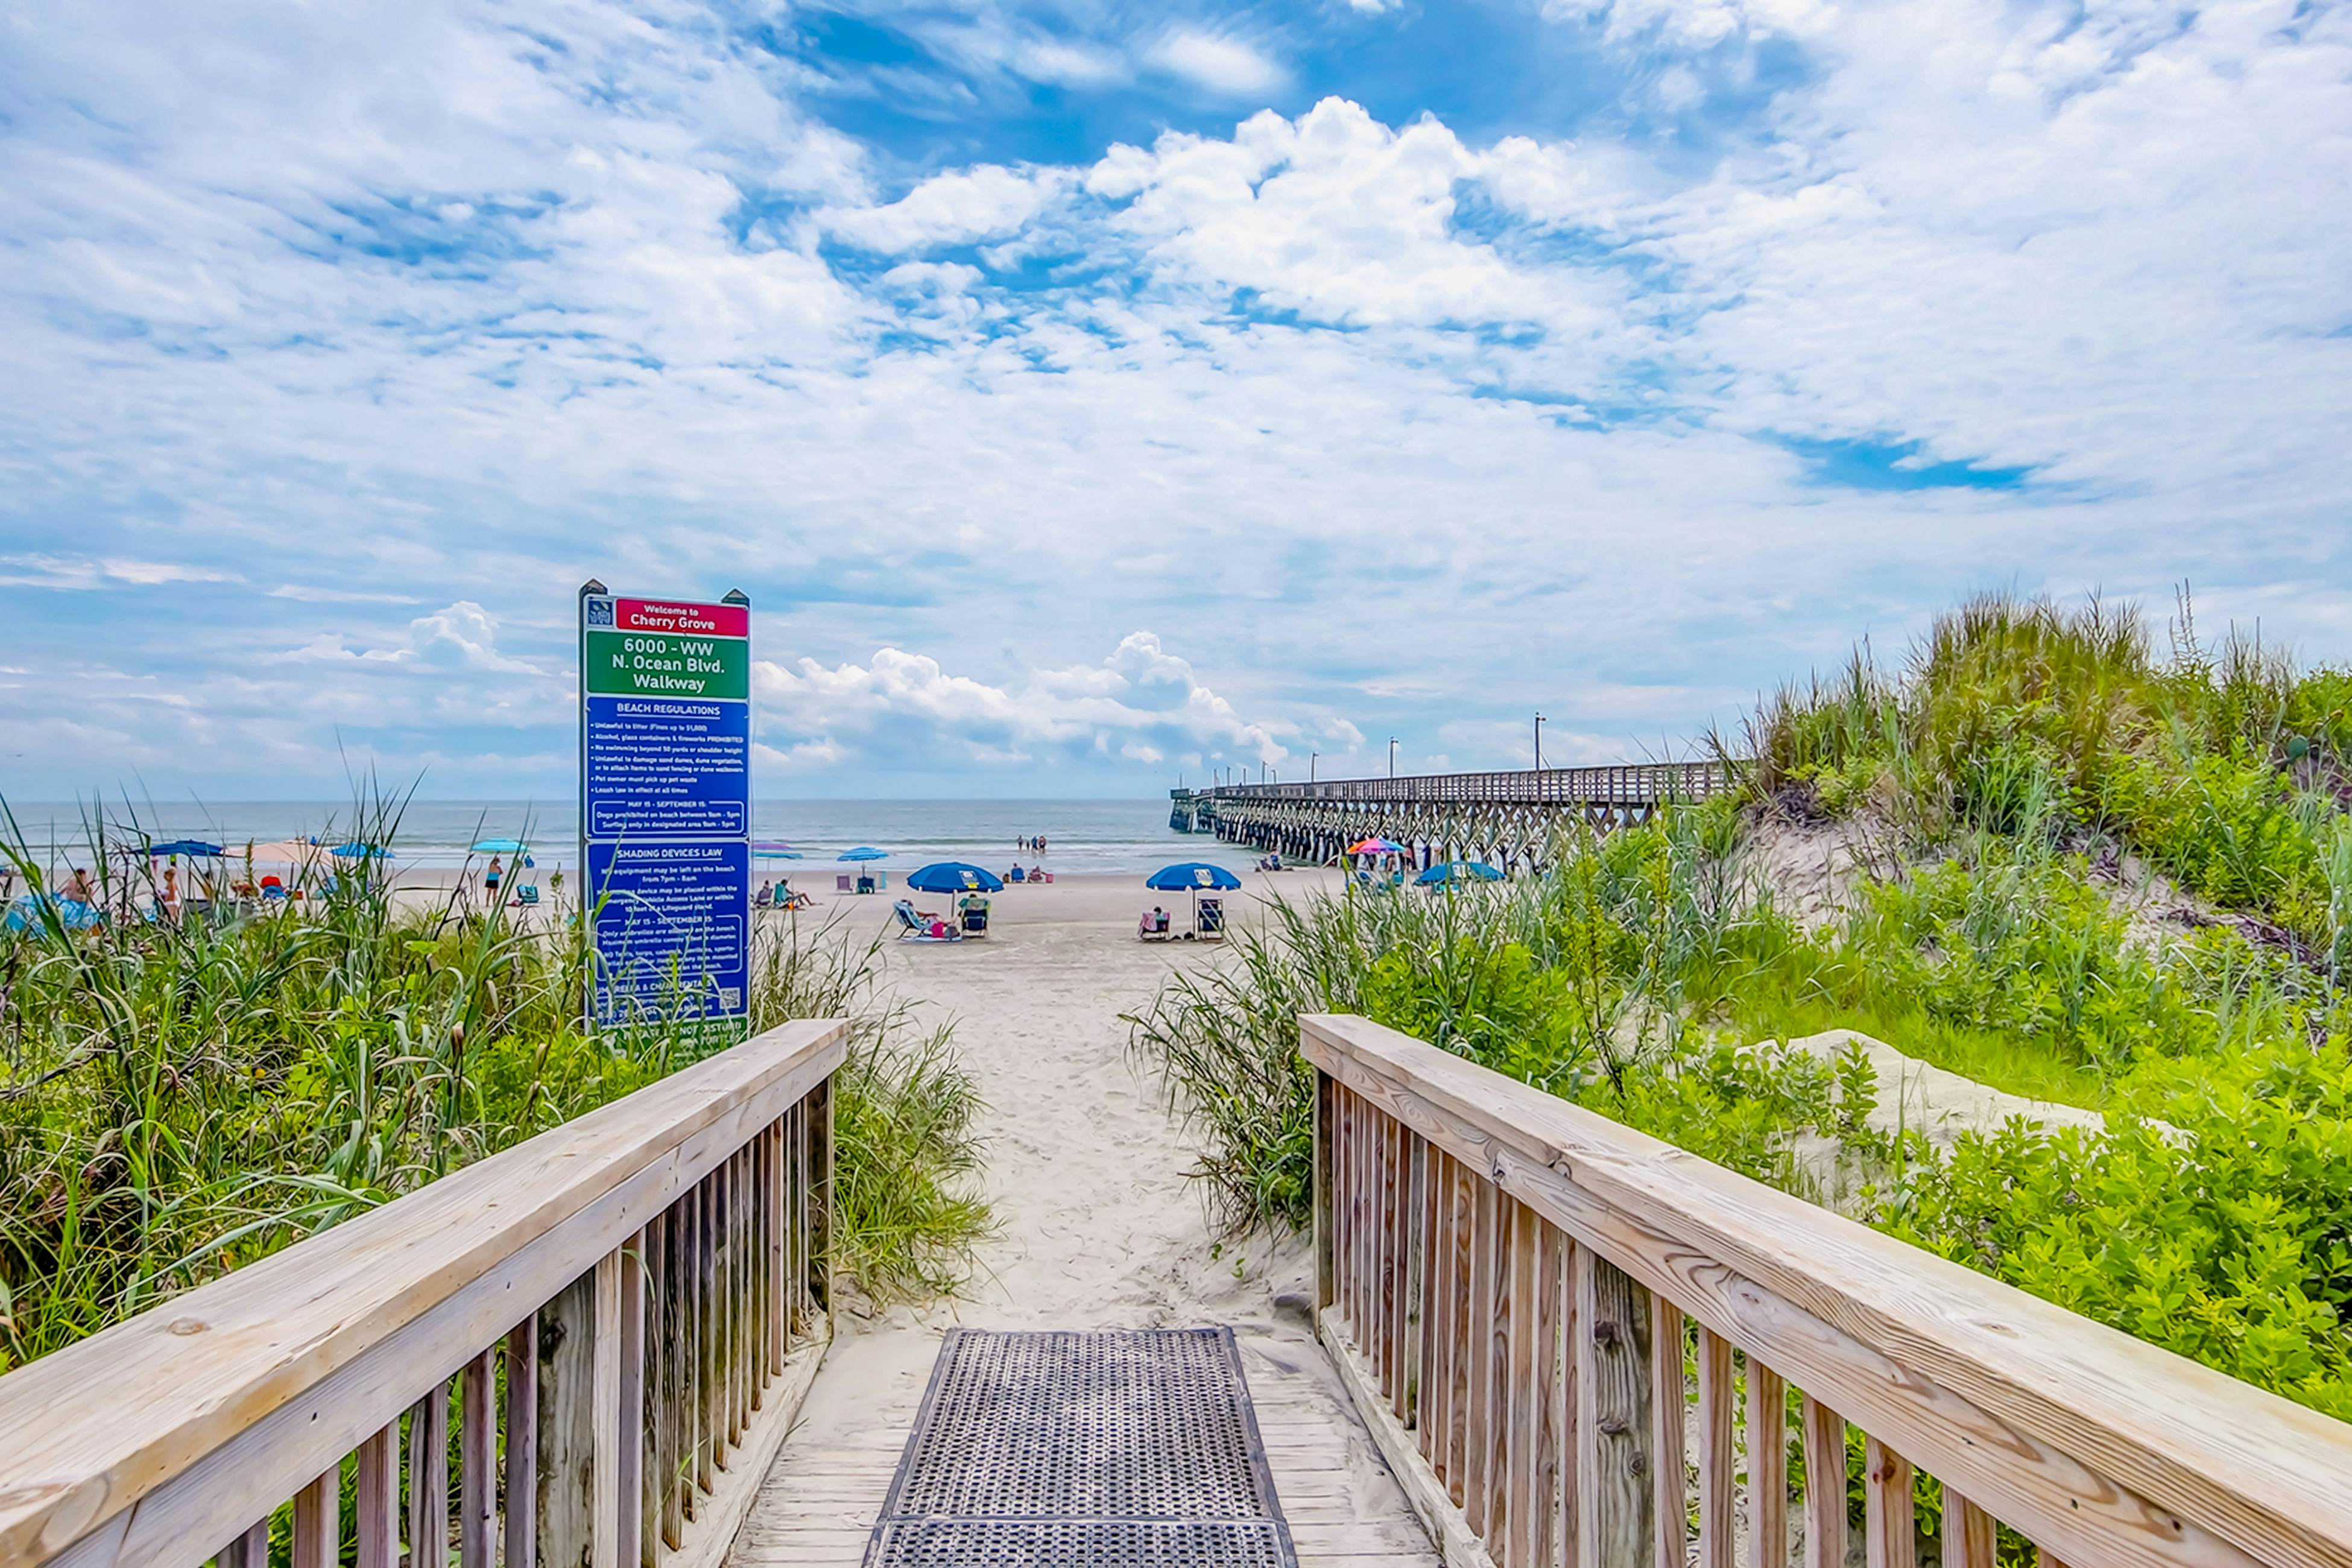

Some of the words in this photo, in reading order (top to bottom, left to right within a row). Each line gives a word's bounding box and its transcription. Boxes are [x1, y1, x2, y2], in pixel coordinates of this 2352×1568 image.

[644, 605, 687, 616] Welcome
[689, 608, 699, 616] to
[630, 613, 675, 630] Cherry
[678, 617, 716, 630] Grove
[624, 637, 666, 654] 6000
[680, 641, 714, 656] WW
[612, 654, 629, 669] N.
[633, 655, 682, 671] Ocean
[687, 658, 725, 674] Blvd.
[633, 674, 706, 694] Walkway
[617, 703, 651, 713] BEACH
[653, 704, 721, 715] REGULATIONS
[617, 849, 660, 858] SHADING
[661, 849, 700, 858] DEVICES
[702, 849, 722, 857] LAW
